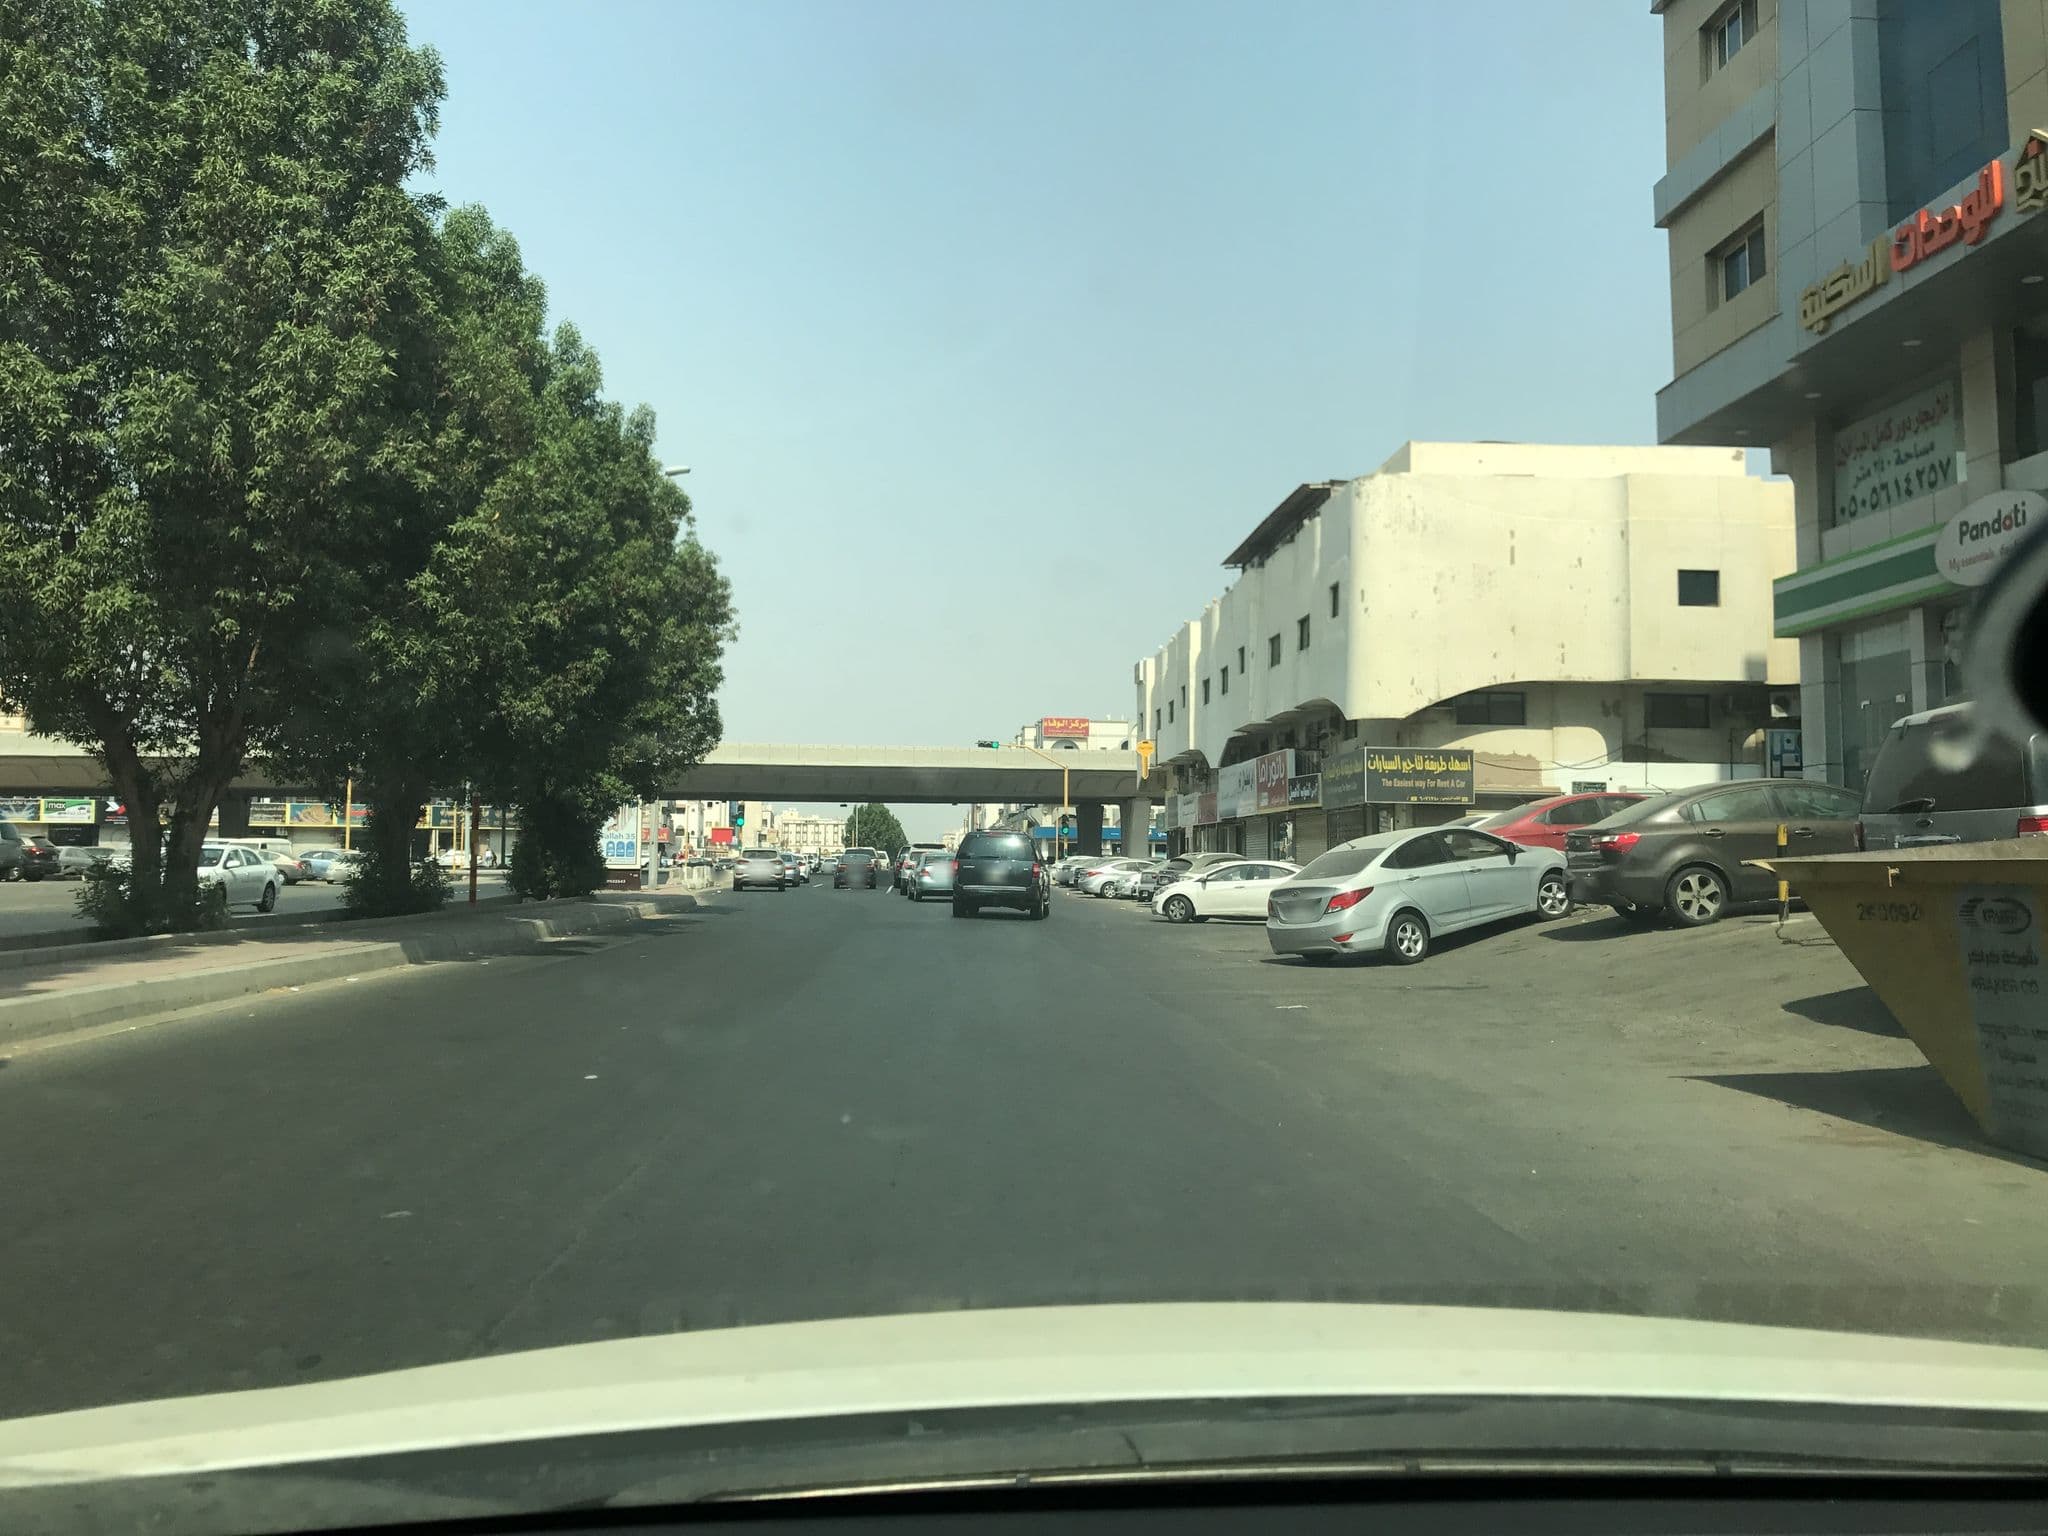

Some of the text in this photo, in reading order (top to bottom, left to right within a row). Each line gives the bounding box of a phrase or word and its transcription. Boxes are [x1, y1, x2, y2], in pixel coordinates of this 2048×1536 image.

[1799, 234, 1890, 335] السكنية
[1958, 501, 2028, 546] Pandoti
[1044, 718, 1088, 729] مركز الوفاء
[1257, 756, 1285, 788] بانوراما
[1367, 753, 1401, 773] السيارات
[1424, 755, 1447, 775] طريقة
[1382, 778, 1393, 788] The
[1393, 778, 1414, 788] Easiest
[1427, 779, 1437, 788] For
[1437, 779, 1450, 788] Rent
[1450, 779, 1456, 788] A
[1456, 779, 1467, 788] Car
